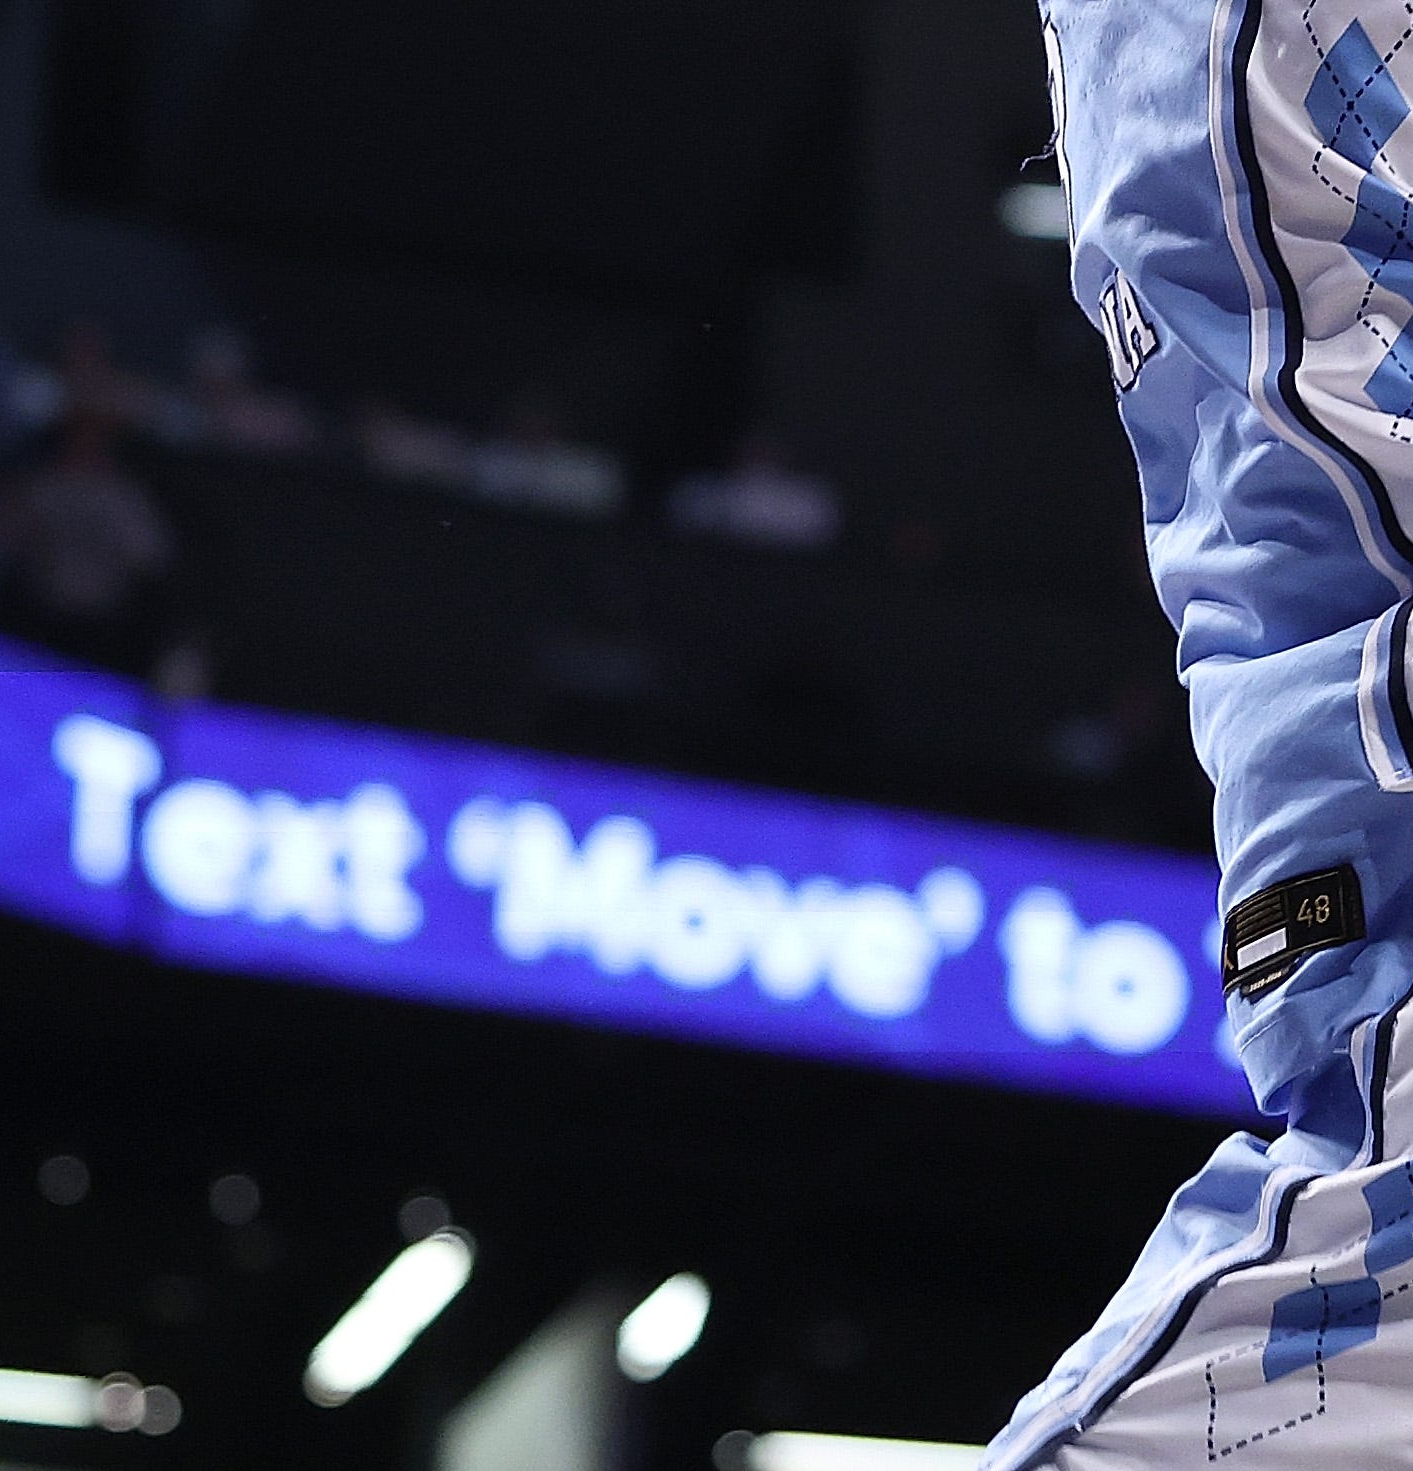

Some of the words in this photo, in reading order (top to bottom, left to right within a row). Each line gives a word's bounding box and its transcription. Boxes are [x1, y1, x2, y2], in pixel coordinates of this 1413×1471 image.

[53, 714, 421, 941] Text
[1004, 889, 1188, 1053] to
[1296, 894, 1331, 928] 48
